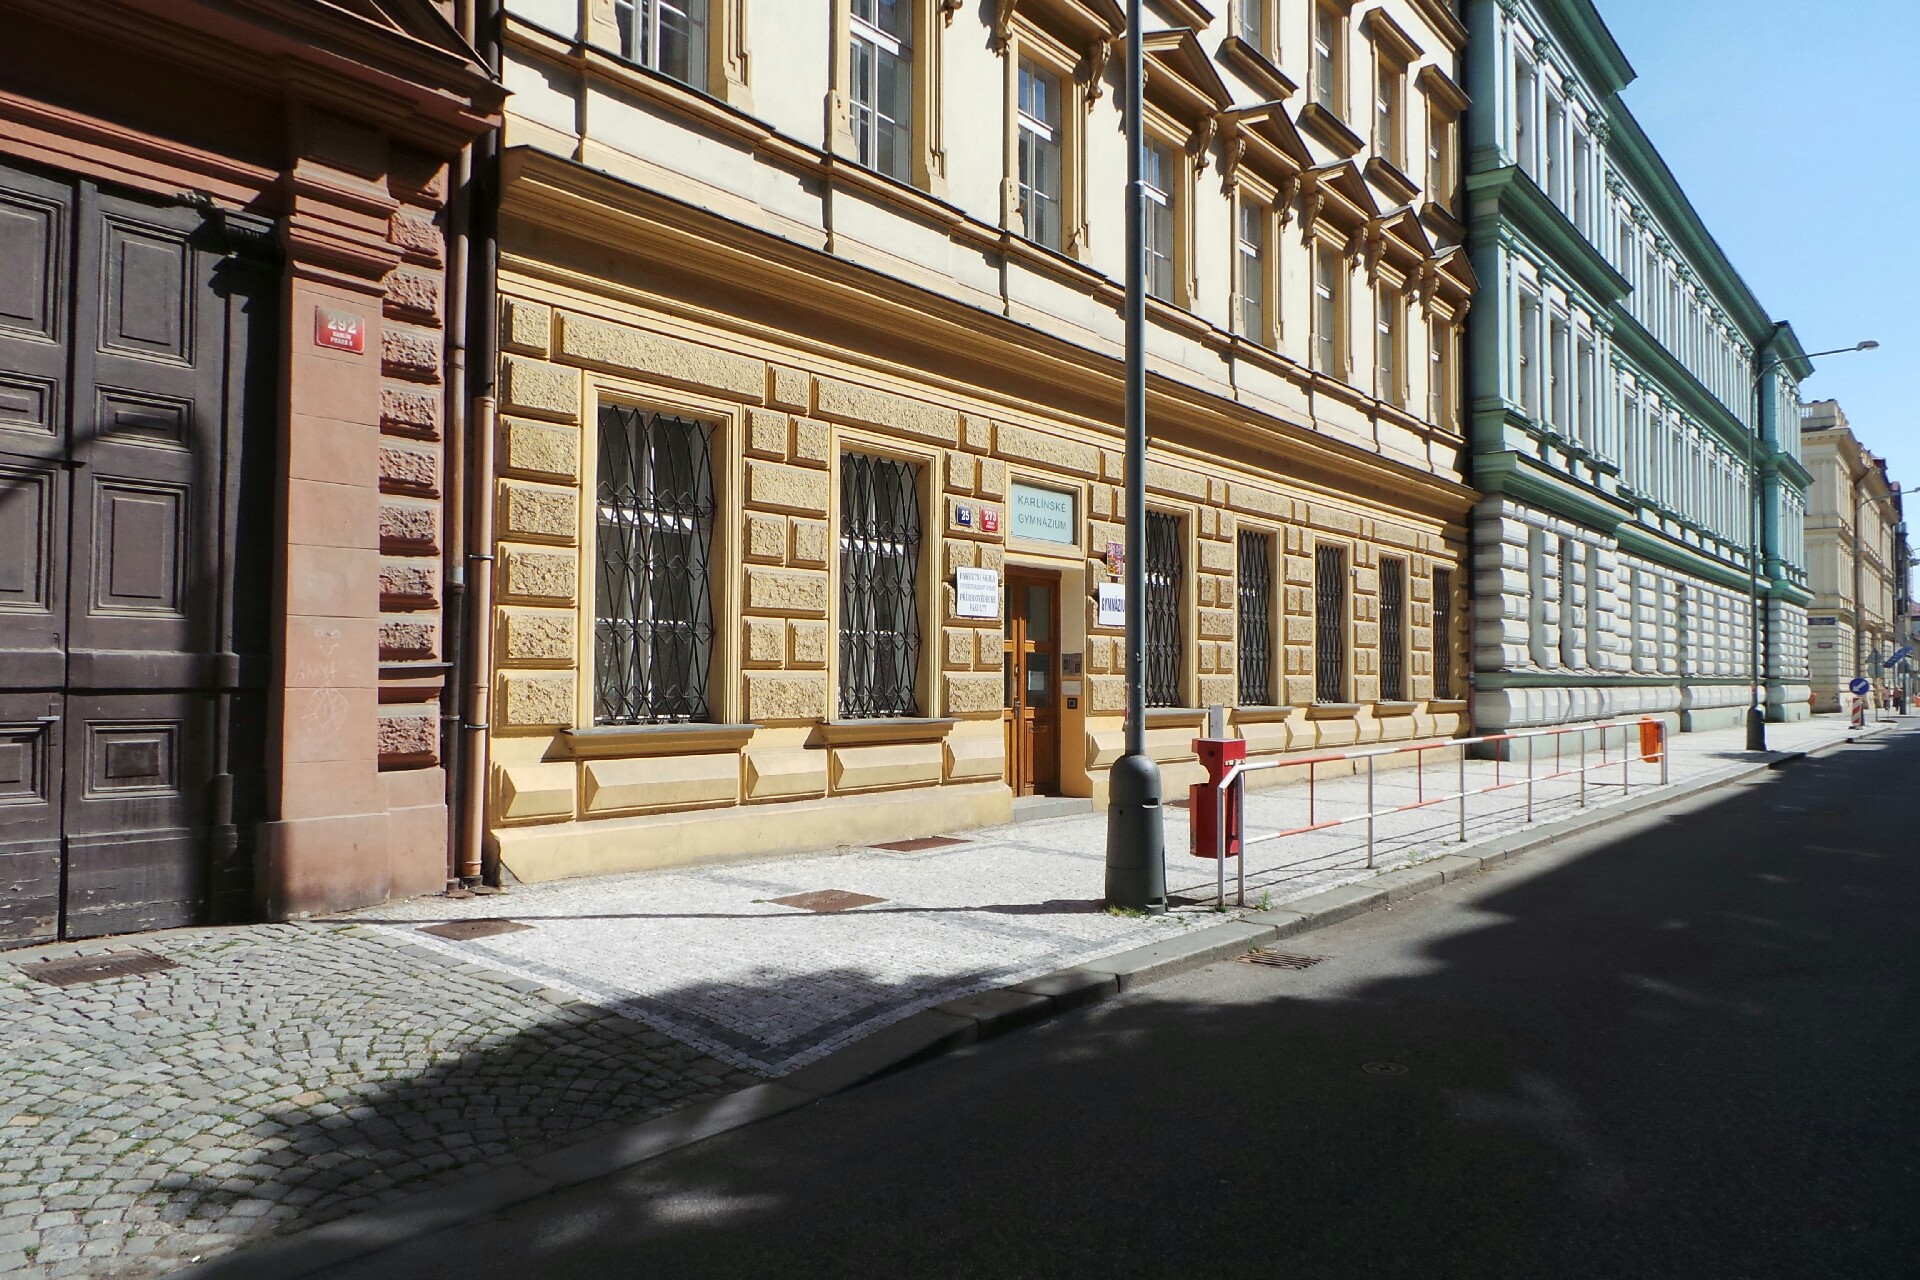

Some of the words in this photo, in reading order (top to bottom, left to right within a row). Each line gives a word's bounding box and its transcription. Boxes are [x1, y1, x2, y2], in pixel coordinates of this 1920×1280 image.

[328, 315, 357, 335] 292
[1017, 495, 1067, 513] KARLÍNSKÉ
[961, 510, 970, 521] 25
[984, 510, 997, 522] 273
[1018, 513, 1067, 531] GYMNÁZIUM
[1101, 596, 1125, 613] GYMNÁZIU
